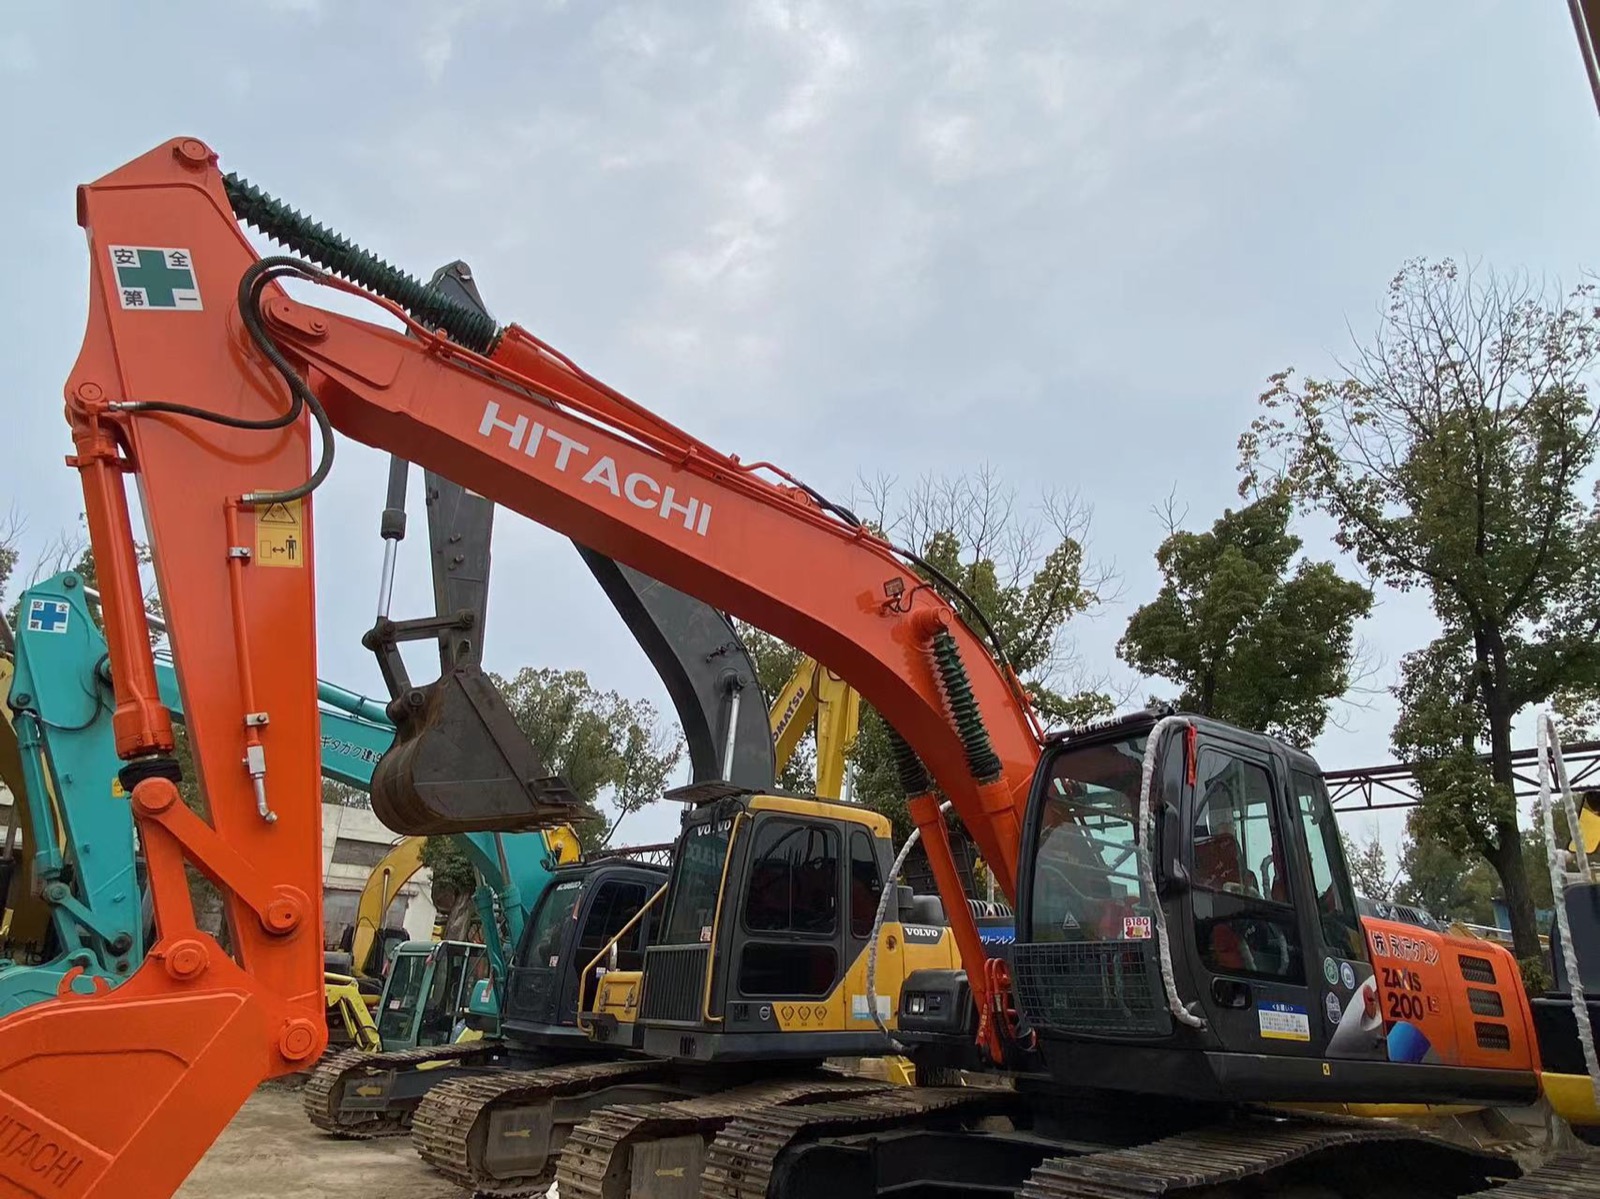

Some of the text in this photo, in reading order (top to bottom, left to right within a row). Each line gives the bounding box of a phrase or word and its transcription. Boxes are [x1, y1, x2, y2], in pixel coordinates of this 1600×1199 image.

[478, 400, 712, 537] HITACHI
[773, 687, 805, 743] OMATSU
[1072, 713, 1124, 735] HITACHI
[697, 820, 732, 837] VOVO
[905, 927, 938, 937] VOLVO
[1125, 917, 1149, 927] B180
[1387, 991, 1425, 1021] 200
